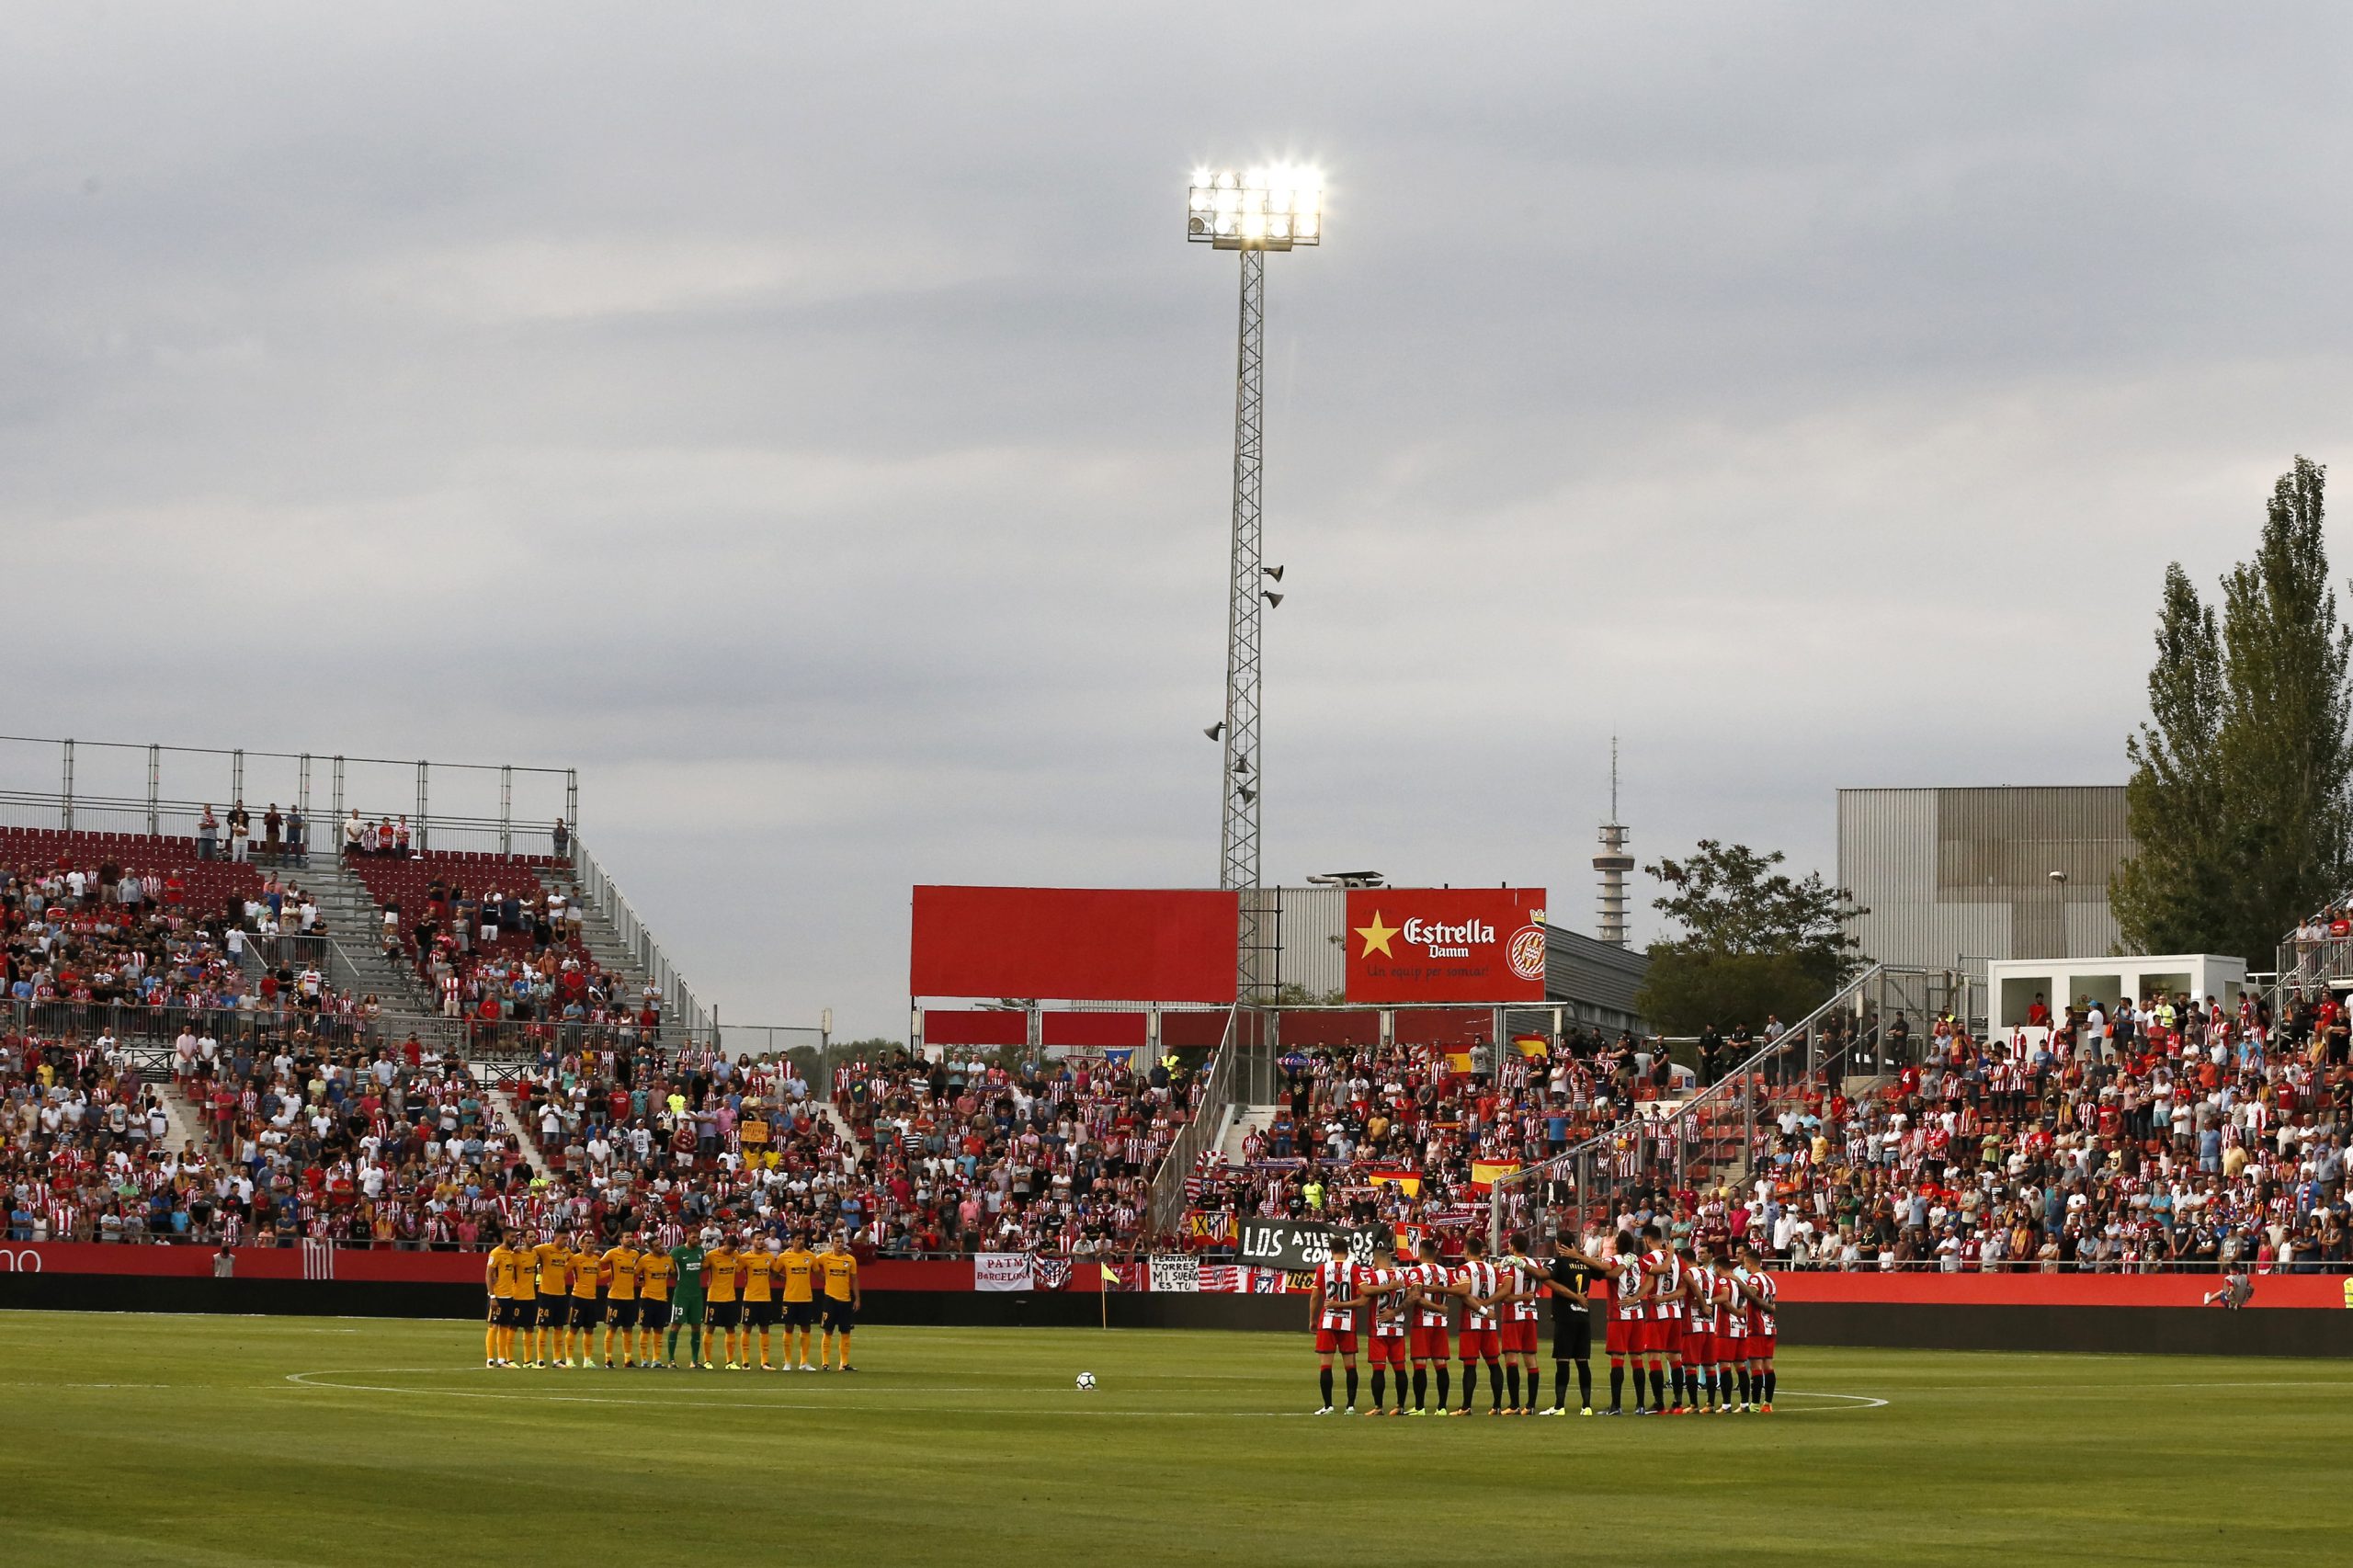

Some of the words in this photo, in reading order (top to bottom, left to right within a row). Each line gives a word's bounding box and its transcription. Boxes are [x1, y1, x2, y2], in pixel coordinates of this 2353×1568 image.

[1403, 917, 1496, 945] Estrella
[1428, 945, 1470, 959] Damm
[1367, 964, 1385, 977] Un
[1391, 966, 1421, 980] equip
[1427, 966, 1441, 981] per
[1903, 1072, 1911, 1084] 4
[1243, 1227, 1284, 1257] LOS
[1153, 1254, 1199, 1262] FERNANDO
[1153, 1263, 1197, 1271] TORRES
[1153, 1271, 1168, 1282] MI
[1176, 1282, 1191, 1290] TU
[1326, 1281, 1349, 1301] 20
[1575, 1274, 1583, 1294] 1
[1626, 1278, 1636, 1295] 2
[675, 1306, 683, 1316] 13
